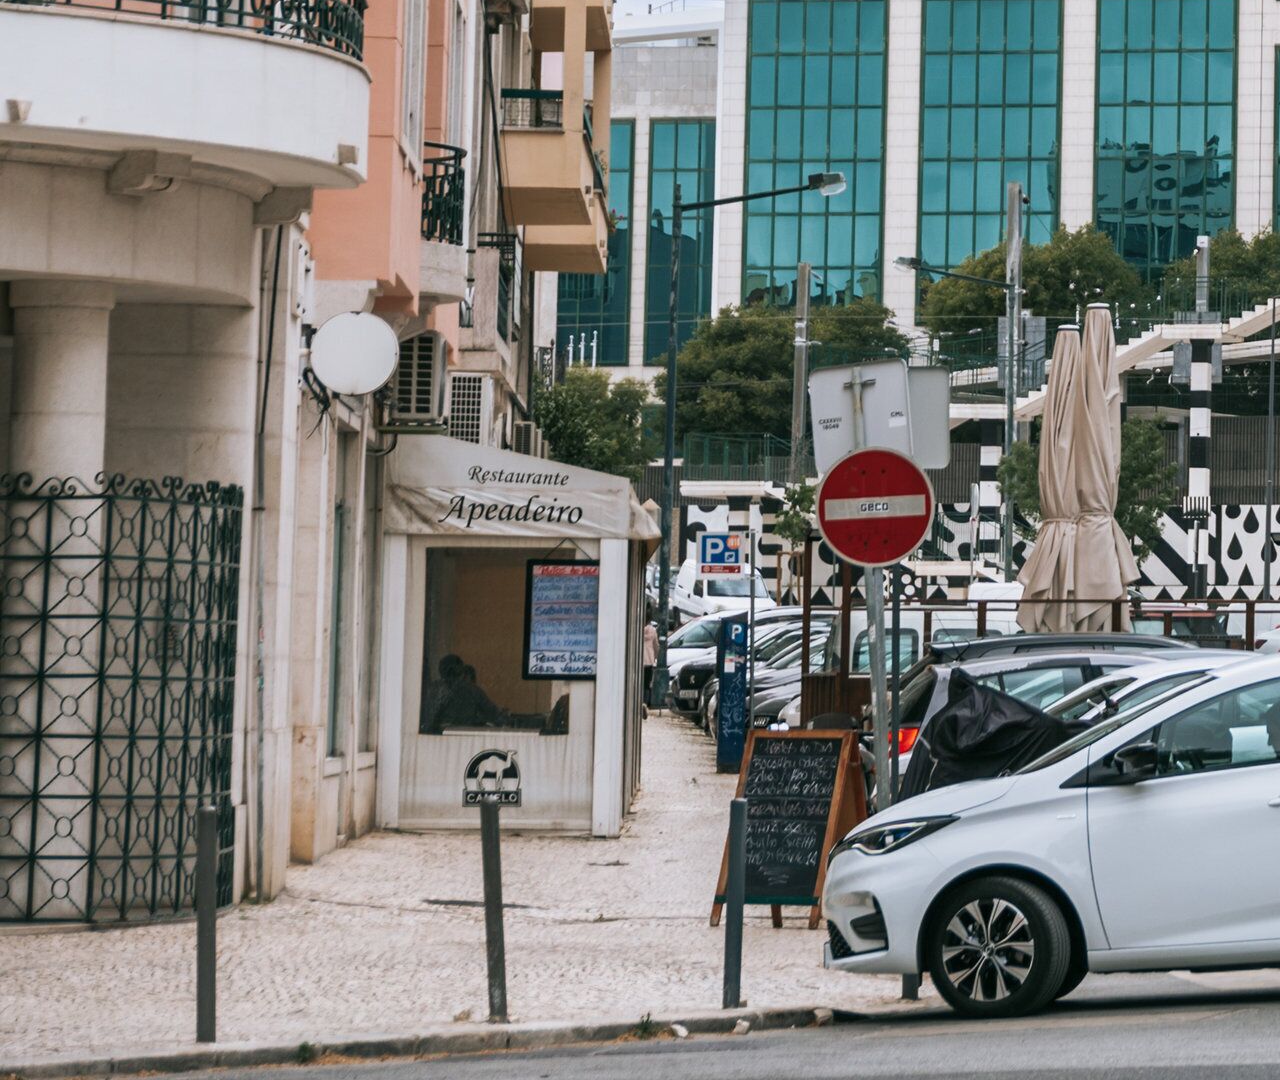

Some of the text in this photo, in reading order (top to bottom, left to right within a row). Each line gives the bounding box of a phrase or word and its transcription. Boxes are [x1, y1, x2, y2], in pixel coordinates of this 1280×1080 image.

[468, 465, 570, 486] Restaurante
[438, 495, 583, 528] Apeadeiro
[706, 538, 724, 562] P
[731, 624, 743, 640] P
